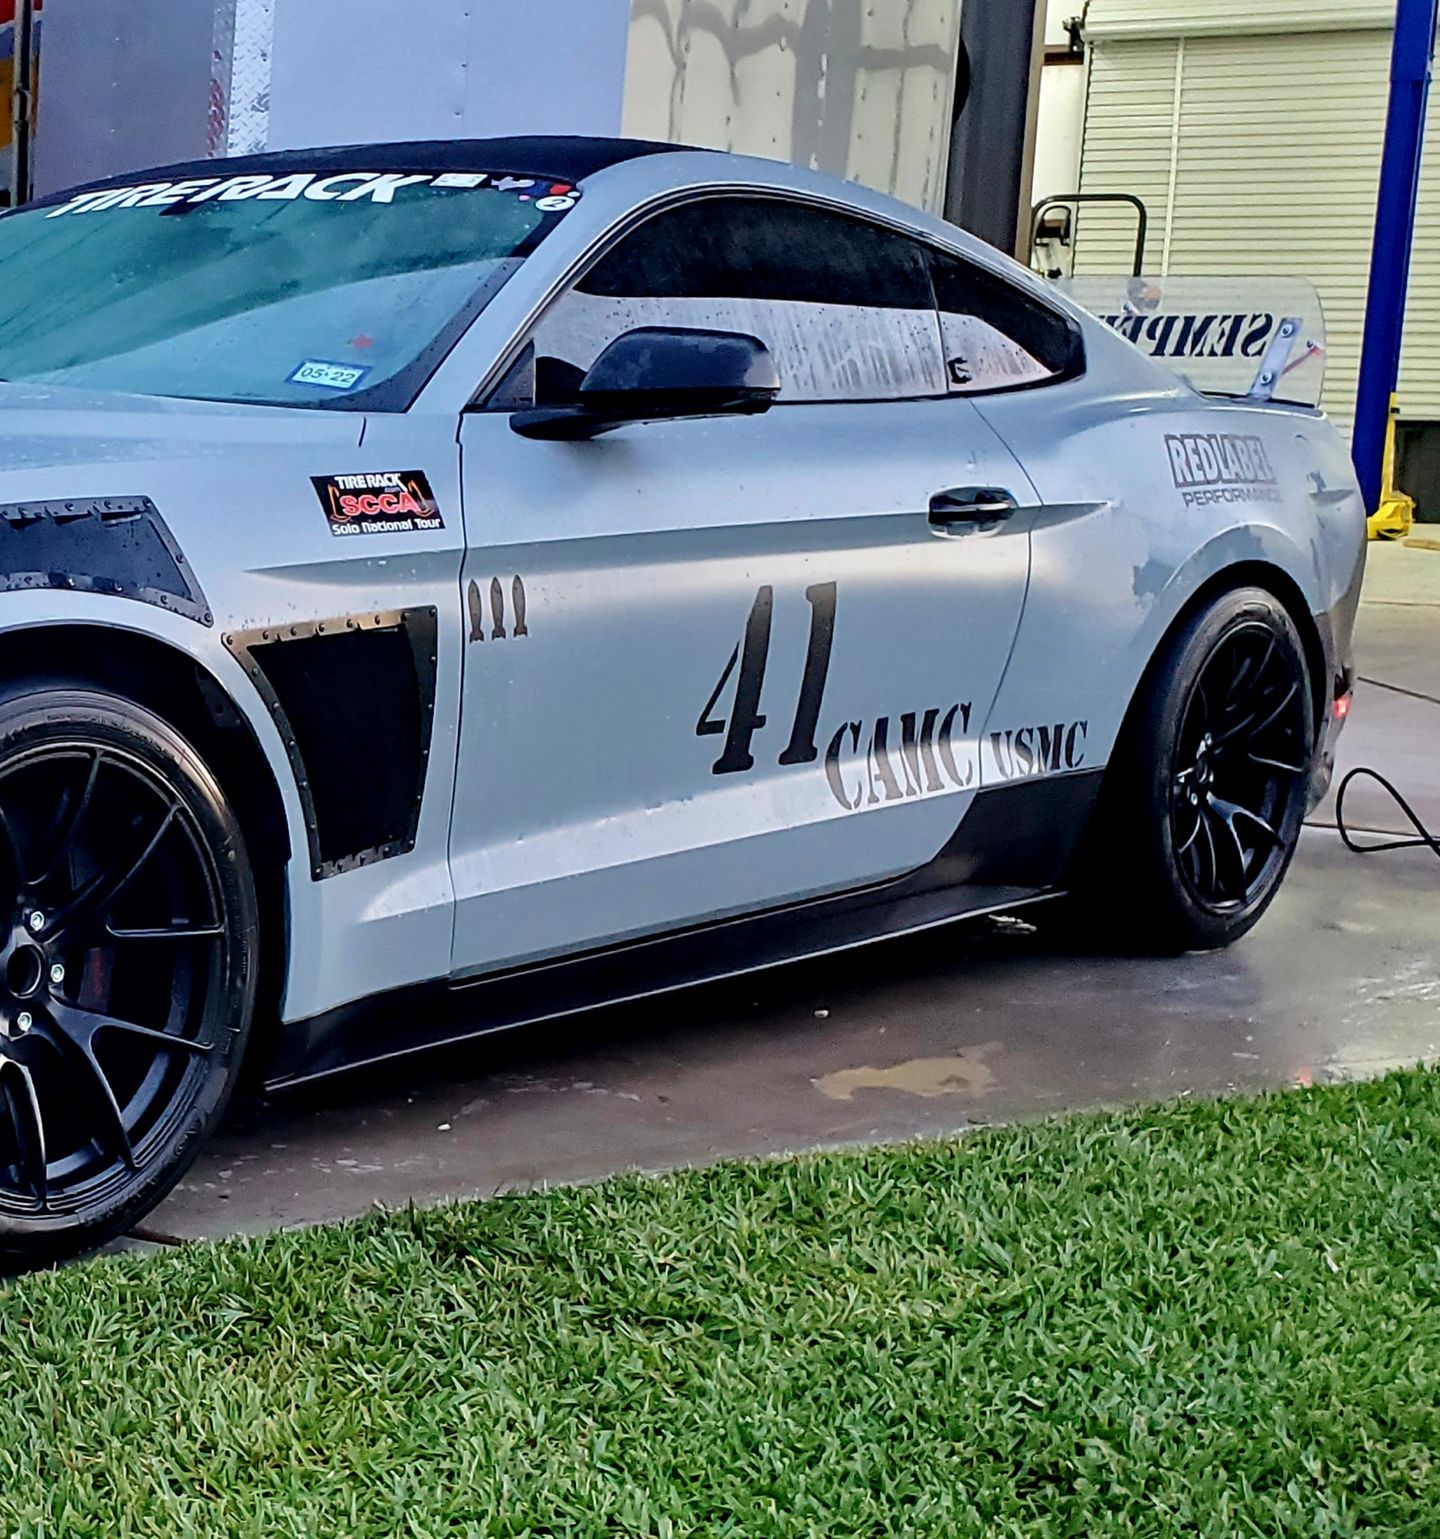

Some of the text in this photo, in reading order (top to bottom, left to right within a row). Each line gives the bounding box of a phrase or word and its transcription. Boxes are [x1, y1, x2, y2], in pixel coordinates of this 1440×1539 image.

[332, 517, 441, 535] Solo National Tour
[339, 492, 422, 516] SCCA
[696, 581, 837, 775] 41
[824, 702, 973, 810] CAMC
[990, 720, 1088, 779] USMC
